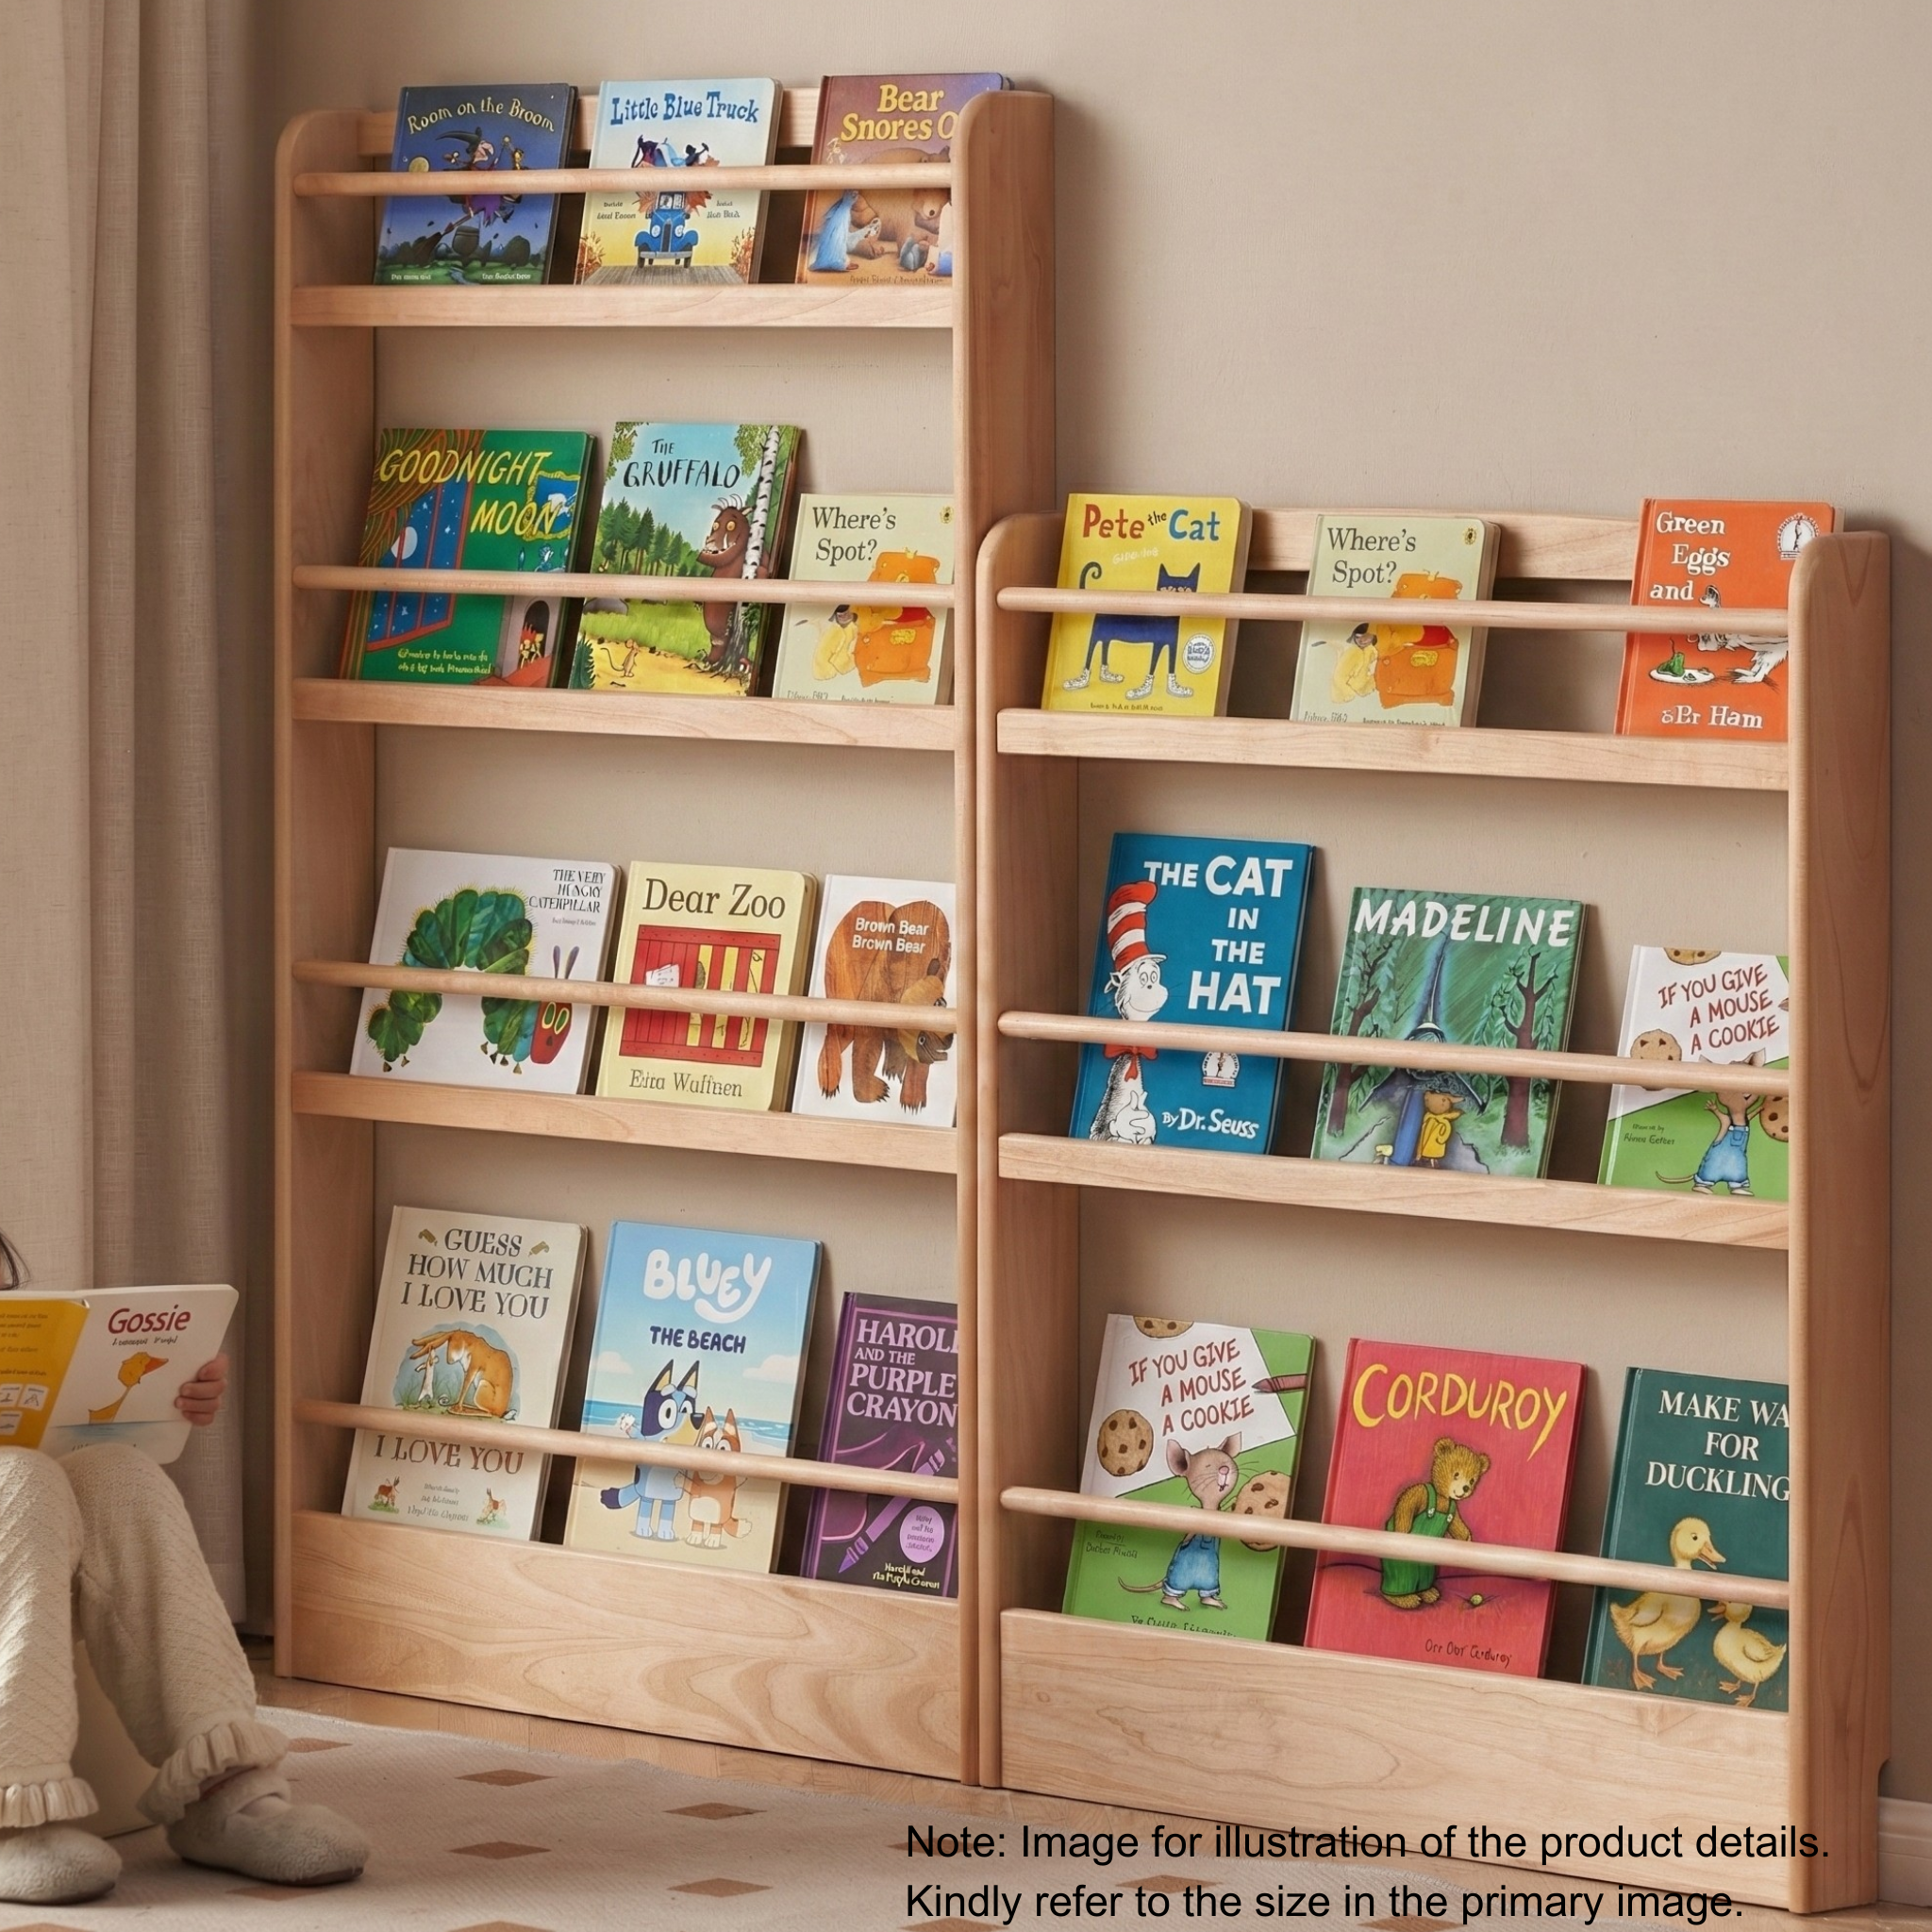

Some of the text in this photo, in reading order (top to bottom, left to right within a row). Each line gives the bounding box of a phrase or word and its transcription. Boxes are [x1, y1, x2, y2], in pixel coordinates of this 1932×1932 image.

[610, 91, 759, 125] Little Blue Truck
[876, 84, 944, 112] Bear
[407, 96, 555, 134] Room on the Broom
[841, 112, 933, 141] Snores
[652, 438, 675, 455] THE
[379, 448, 553, 486] GOODNIGHT
[623, 458, 741, 489] GRUFFALO
[471, 499, 564, 537] MOON
[812, 507, 897, 530] Where's
[1082, 503, 1221, 541] Pete the Cat
[1656, 510, 1725, 535] Green
[815, 538, 878, 567] Spot?
[1327, 526, 1416, 552] Where's
[1332, 559, 1397, 588] Spot?
[1671, 542, 1731, 575] Eggs
[1649, 580, 1694, 601] and
[1707, 705, 1763, 729] Ham
[553, 868, 576, 882] THE
[1143, 855, 1293, 897] THE CAT
[642, 877, 786, 920] Dear Zoo
[855, 917, 930, 936] Brown Bear
[1227, 907, 1259, 930] IN
[1353, 898, 1574, 947] MADELINE
[895, 937, 926, 955] Bear
[1211, 939, 1266, 965] THE
[1188, 970, 1282, 1015] HAT
[1657, 963, 1768, 1009] IF YOU GIVE
[1690, 989, 1774, 1028] A MOUSE
[1690, 1014, 1780, 1056] A COOKIE
[1178, 1107, 1208, 1132] Dr.
[1208, 1108, 1260, 1140] Seuss
[444, 1227, 524, 1258] GUESS
[407, 1253, 554, 1290] HOW MUCH
[642, 1248, 772, 1324] BLUEY
[400, 1281, 550, 1320] I LOVE YOU
[108, 1304, 192, 1334] Gossie
[649, 1325, 746, 1355] THE BEACH
[854, 1346, 916, 1365] AND THE
[1128, 1338, 1241, 1387] IF YOU GIVE
[849, 1363, 957, 1398] PURPLE
[1160, 1366, 1246, 1407] A MOUSE
[846, 1391, 958, 1427] CRAYON
[1162, 1394, 1255, 1437] A COOKIE
[1351, 1363, 1569, 1463] CORDUROY
[1658, 1390, 1741, 1422] MAKE
[374, 1434, 525, 1474] I LOVE YOU
[1704, 1431, 1759, 1461] FOR
